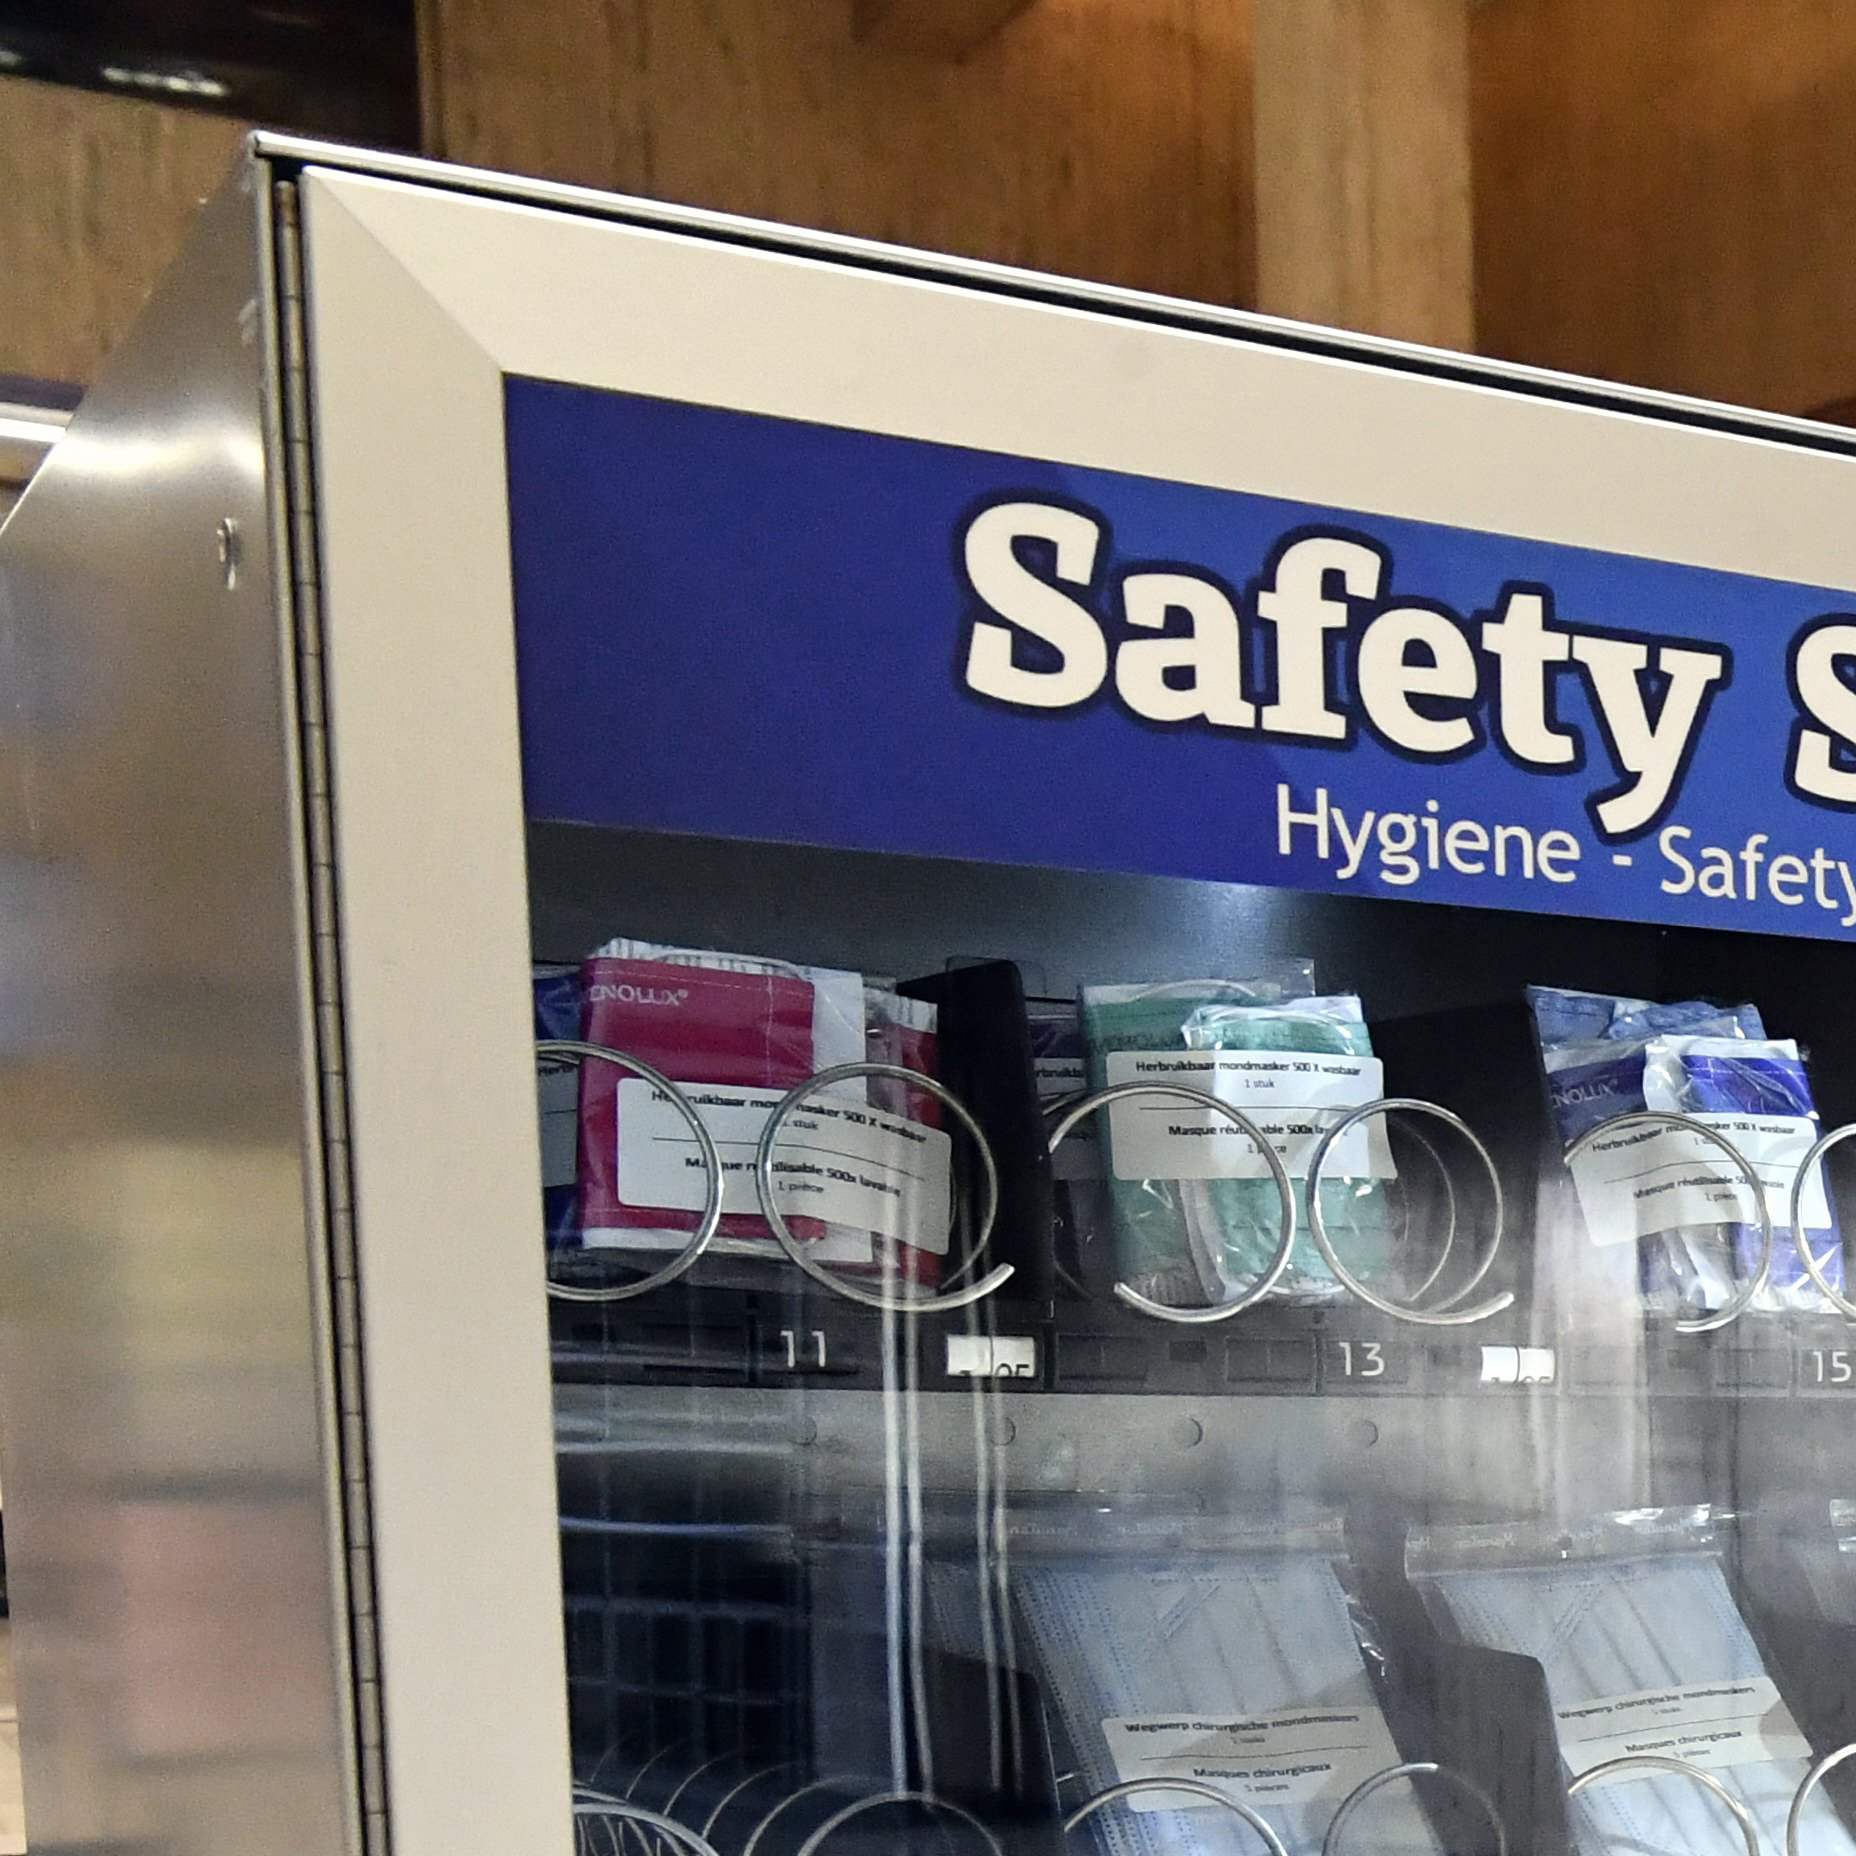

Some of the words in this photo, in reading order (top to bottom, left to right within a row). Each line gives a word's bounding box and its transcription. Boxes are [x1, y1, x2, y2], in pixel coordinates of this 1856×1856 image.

[965, 503, 1722, 834] Safety
[1274, 787, 1580, 884] Hygiene
[1136, 1060, 1216, 1074] Herbruikbaar
[1218, 1061, 1291, 1073] mondmasker
[1168, 1124, 1217, 1138] Masque
[780, 1329, 826, 1368] 11
[1339, 1341, 1385, 1377] 13
[1812, 1350, 1852, 1383] 15
